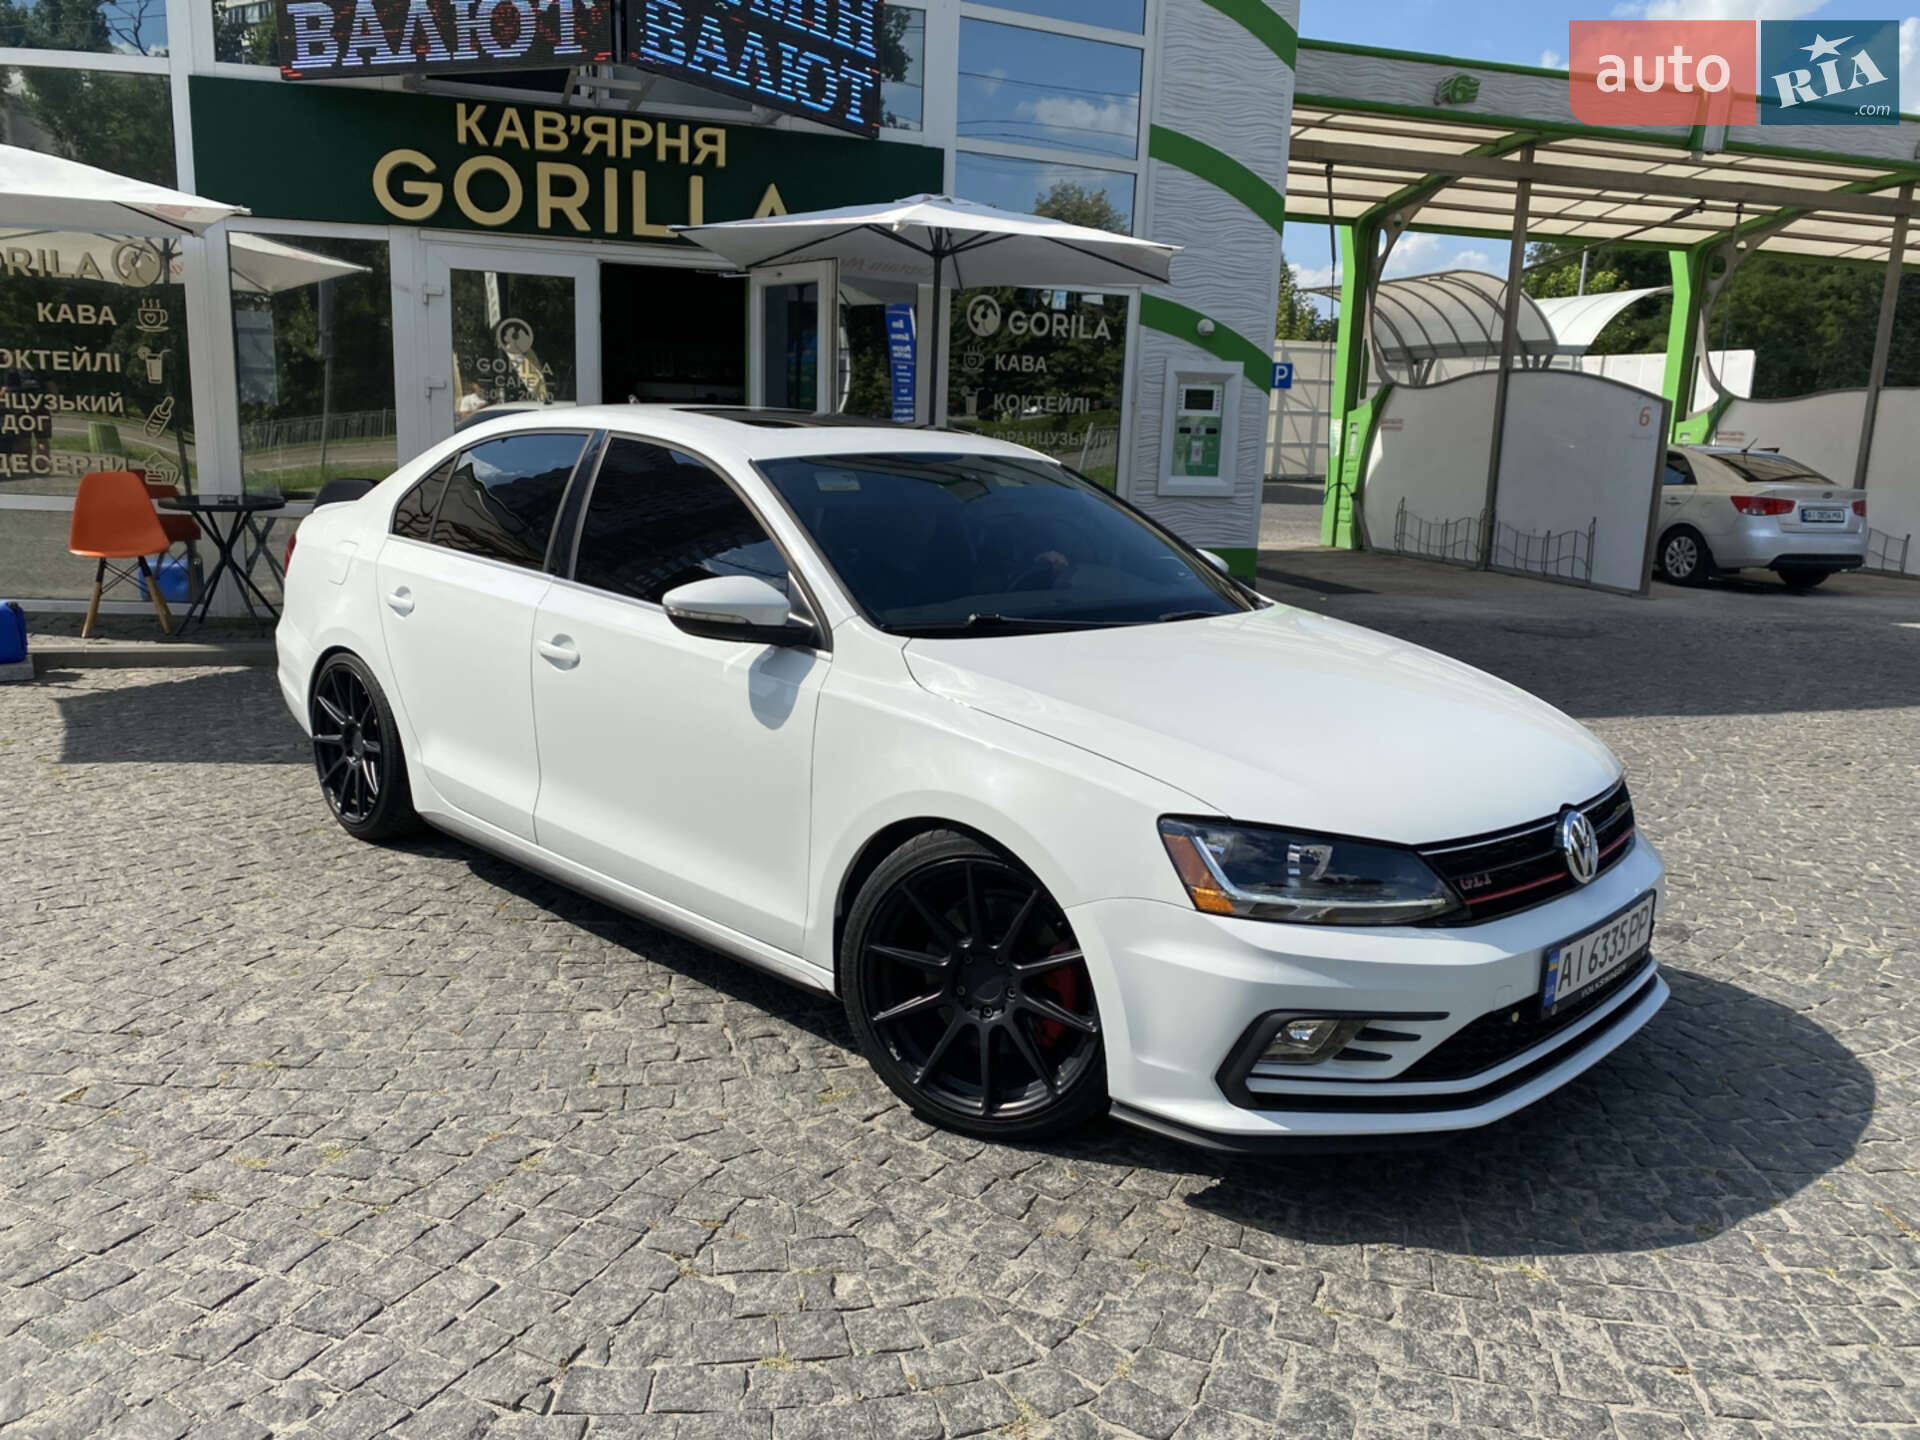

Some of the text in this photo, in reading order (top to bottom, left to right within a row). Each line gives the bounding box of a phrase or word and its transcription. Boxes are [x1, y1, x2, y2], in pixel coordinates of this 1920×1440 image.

[640, 0, 874, 123] ВАЛЮТ
[0, 247, 104, 280] RILA
[37, 302, 117, 325] КАВА
[1008, 310, 1111, 341] GORILA
[995, 354, 1047, 373] КАВА
[1274, 365, 1288, 387] P
[993, 392, 1090, 414] КОКТЕЙЛІ
[1, 415, 50, 434] ДОГ
[1639, 406, 1650, 426] 6
